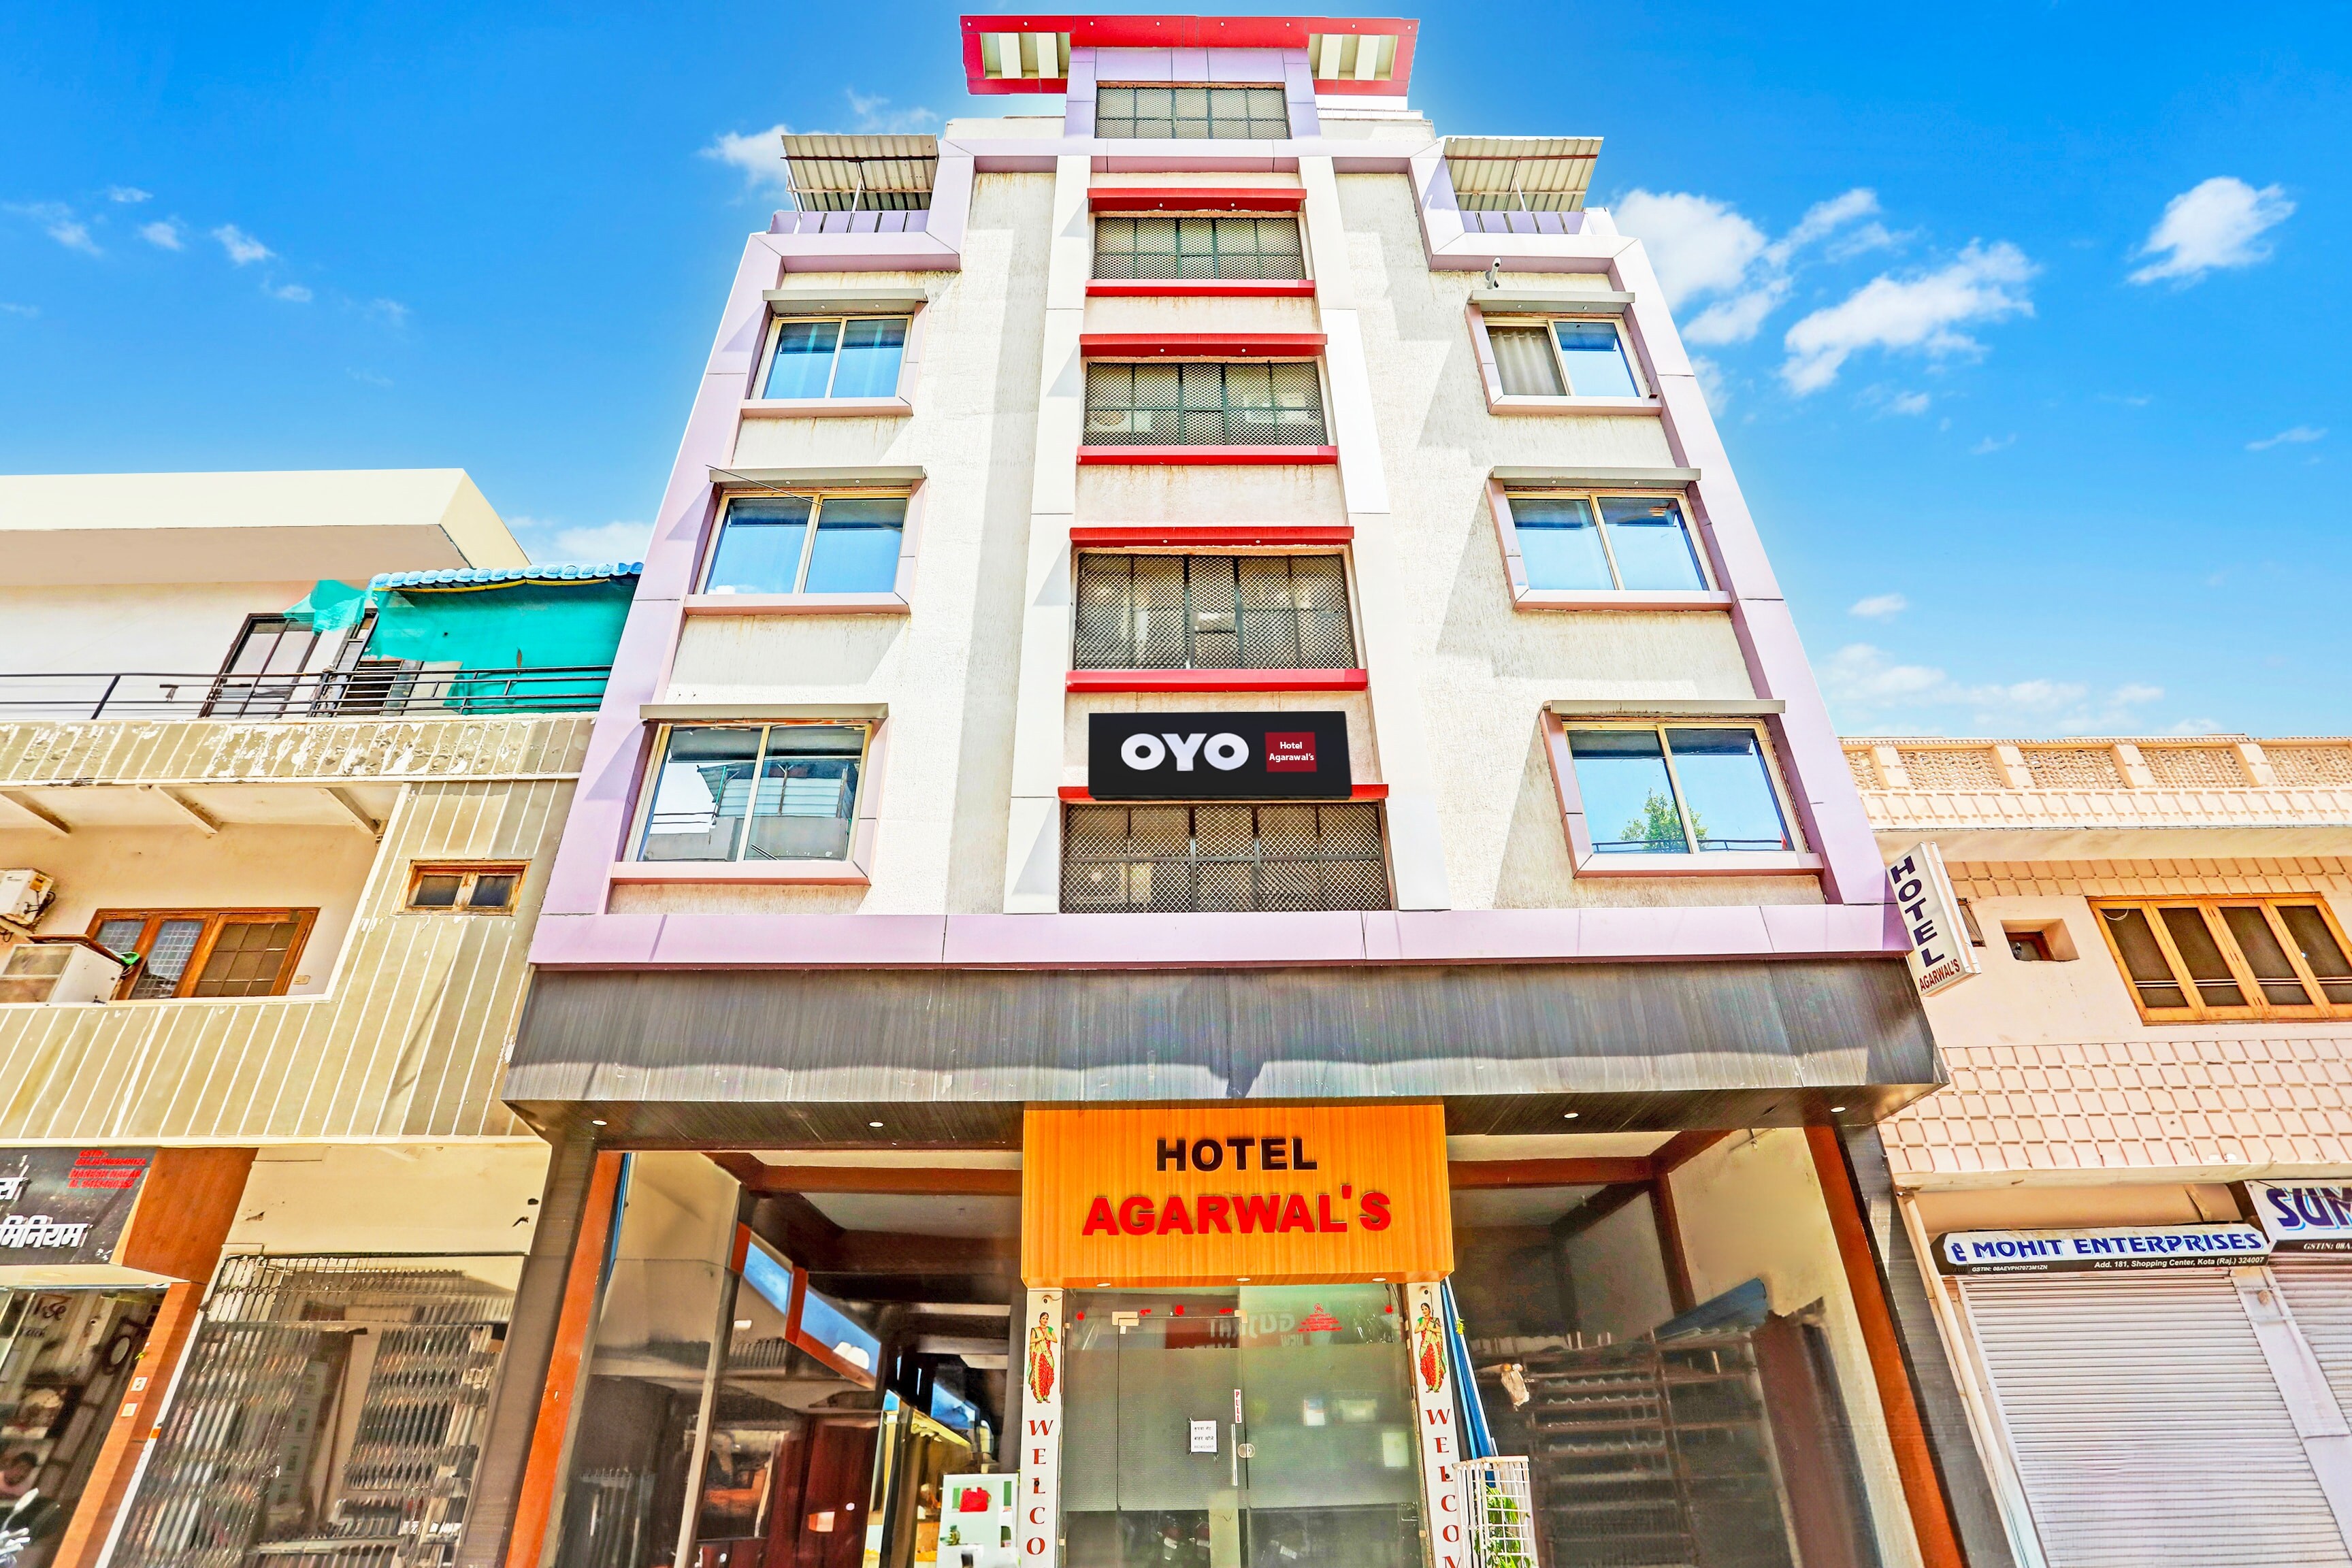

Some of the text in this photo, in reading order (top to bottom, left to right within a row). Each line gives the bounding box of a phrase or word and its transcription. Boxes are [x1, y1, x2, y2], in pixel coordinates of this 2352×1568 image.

[1121, 732, 1250, 772] OYO
[1279, 741, 1303, 750] Hotel
[1891, 855, 1945, 968] HOTEL
[1919, 958, 1961, 992] AGARWAL'S
[1156, 1137, 1318, 1172] HOTEL
[1081, 1184, 1392, 1236] AGARWAL'S
[1972, 1239, 2062, 1258] MOHIT
[2074, 1232, 2263, 1254] ENTERPRISES
[2093, 1261, 2112, 1269] Add.
[2131, 1260, 2168, 1269] Shopping
[2169, 1259, 2195, 1267] Center,
[2217, 1257, 2236, 1266] (Raj.)
[2238, 1256, 2265, 1264] 324007
